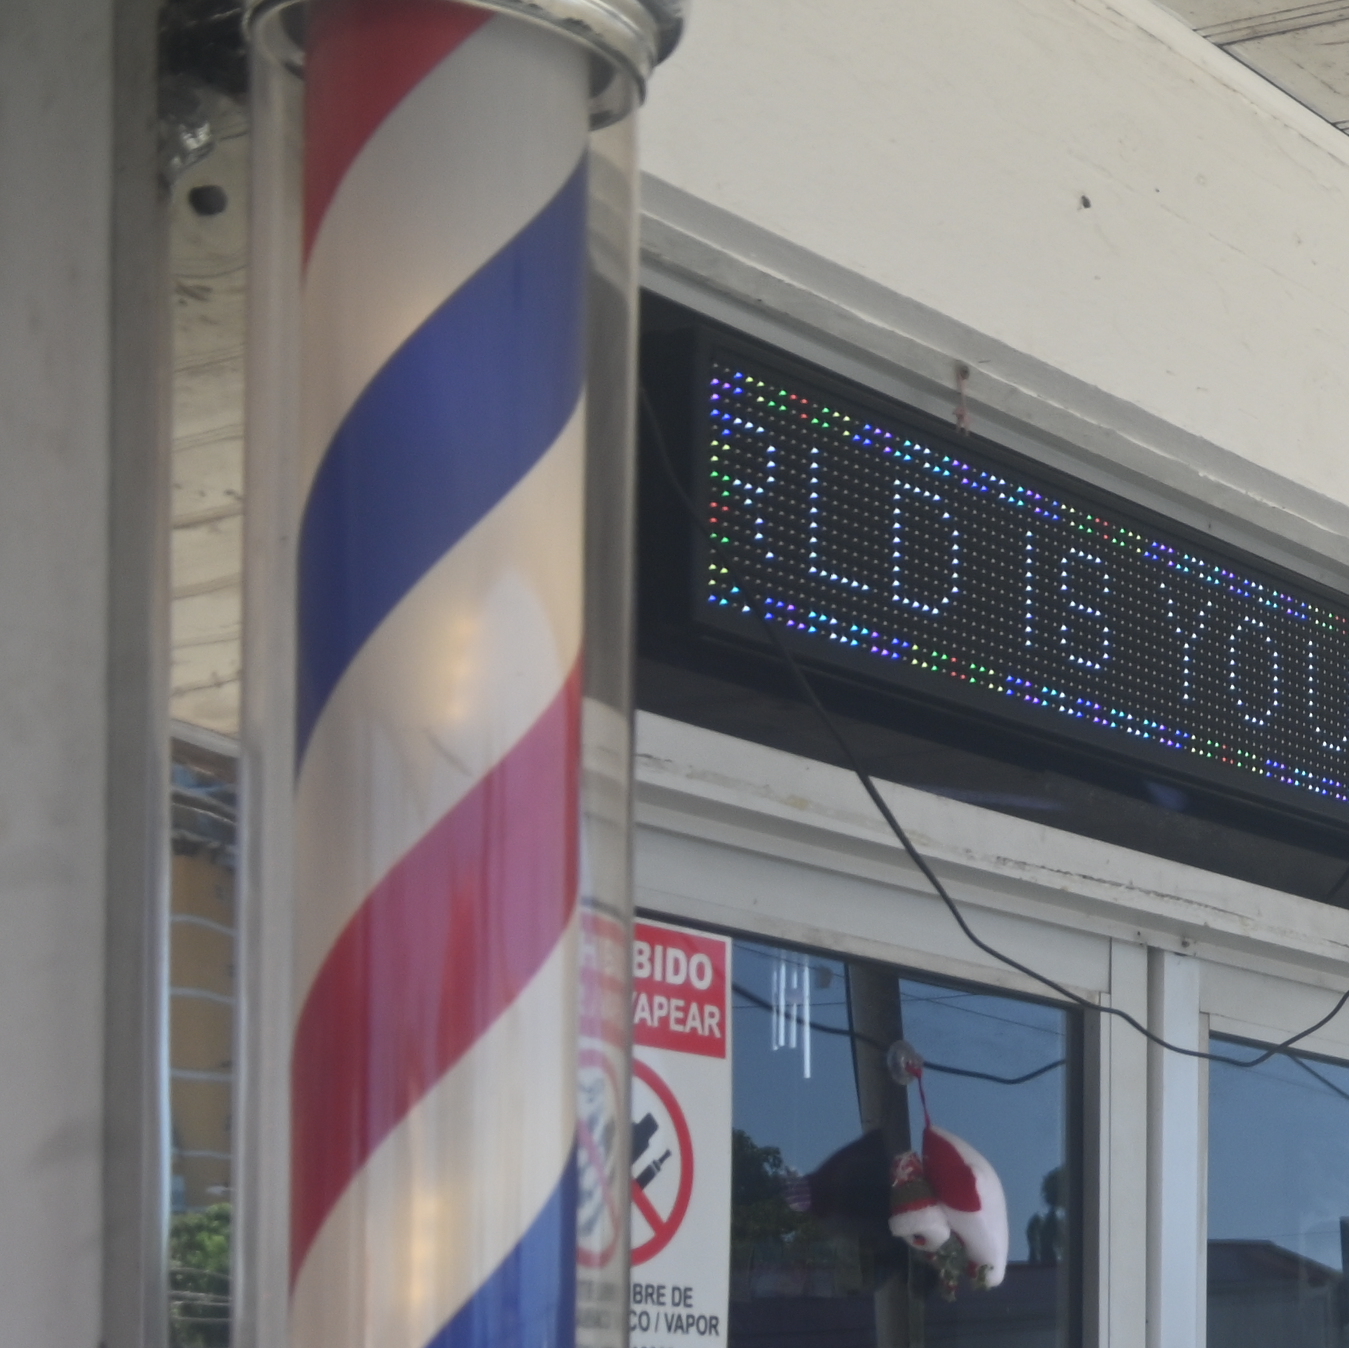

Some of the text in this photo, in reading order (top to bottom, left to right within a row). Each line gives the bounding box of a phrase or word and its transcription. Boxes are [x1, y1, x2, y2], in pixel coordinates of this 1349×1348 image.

[633, 940, 713, 990] BIDO
[632, 1283, 666, 1306] BRE
[671, 1287, 693, 1308] DE
[664, 1313, 719, 1336] VAPOR
